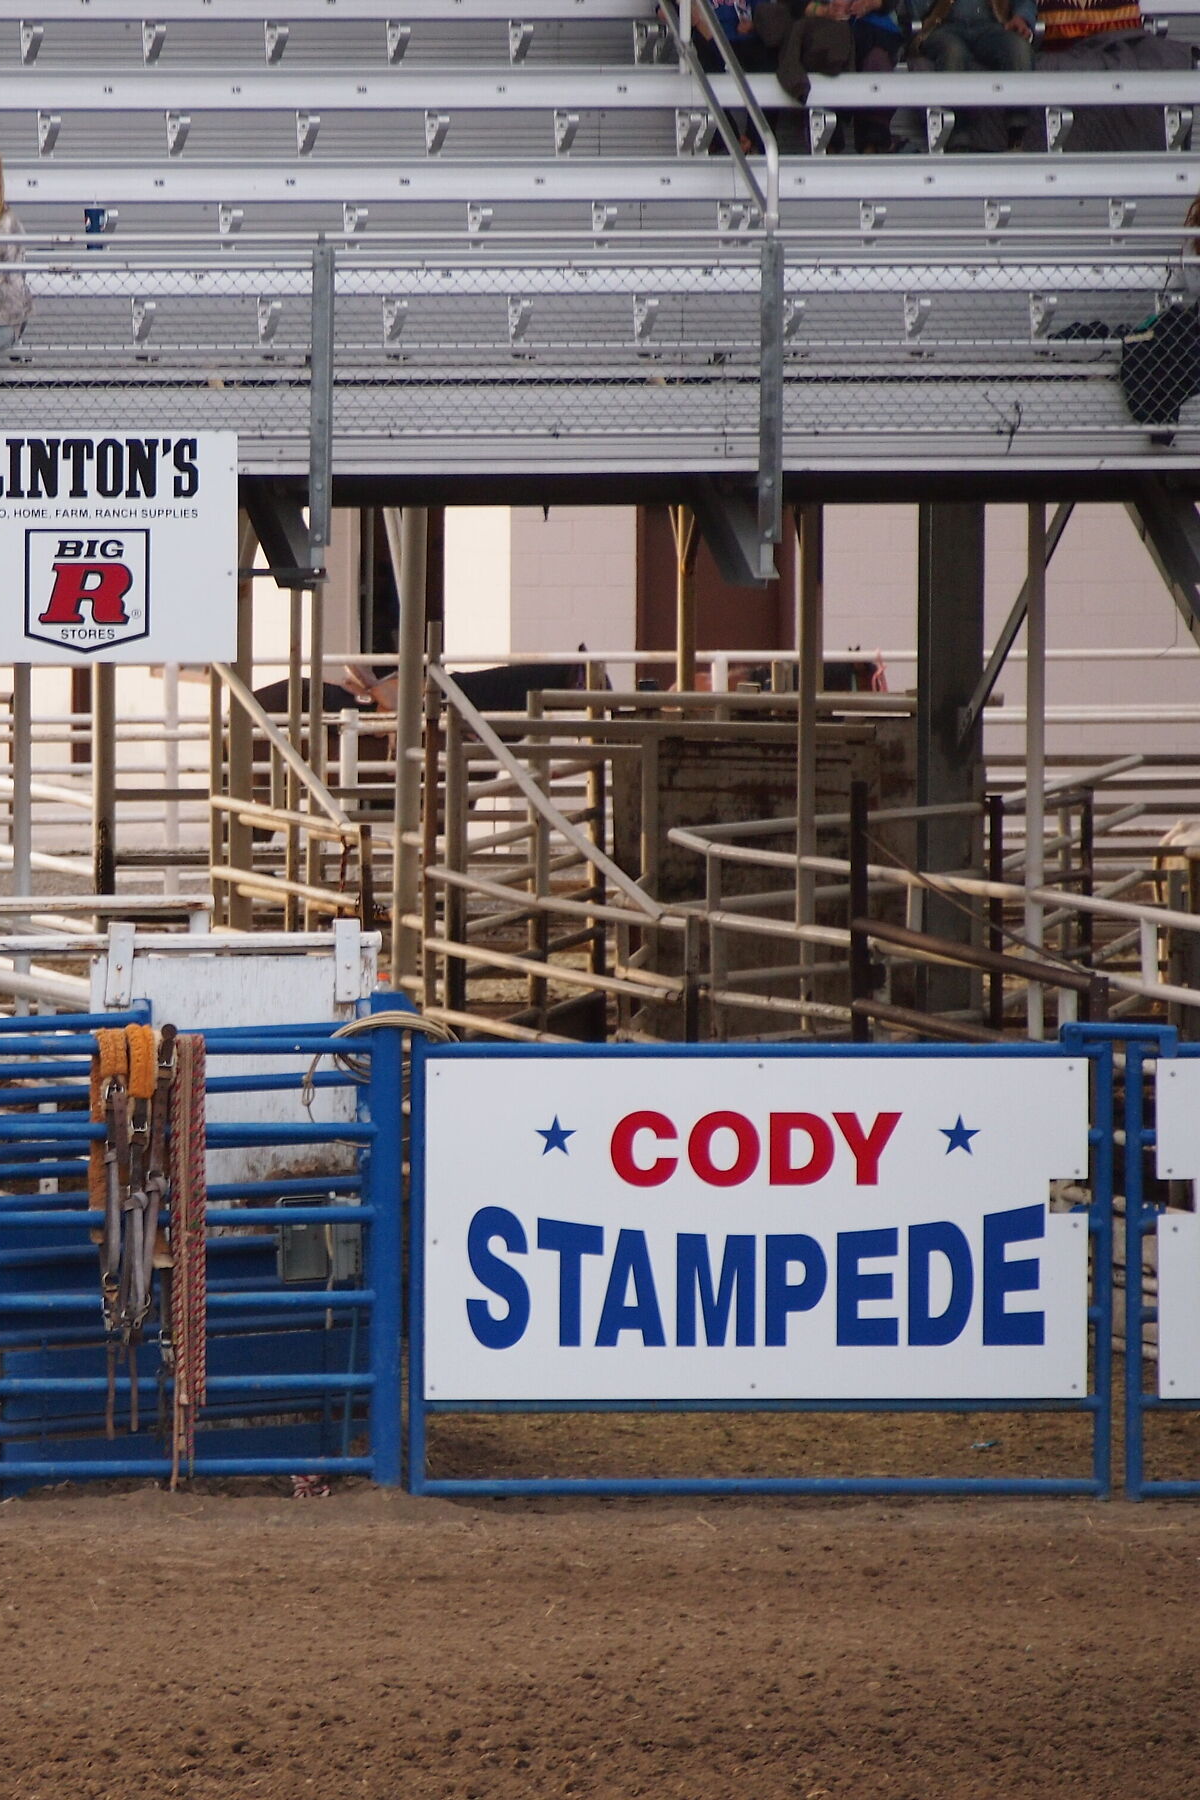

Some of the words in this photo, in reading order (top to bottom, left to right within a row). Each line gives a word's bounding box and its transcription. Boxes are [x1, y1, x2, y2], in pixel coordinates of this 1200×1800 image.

[13, 508, 51, 521] HOME,
[55, 508, 92, 521] FARM,
[95, 508, 138, 519] RANCH
[141, 508, 199, 519] SUPPLIES
[54, 539, 125, 558] BIG
[38, 562, 133, 625] R
[60, 628, 116, 640] STORES
[610, 1110, 903, 1188] CODY
[466, 1204, 1045, 1350] STAMPEDE
